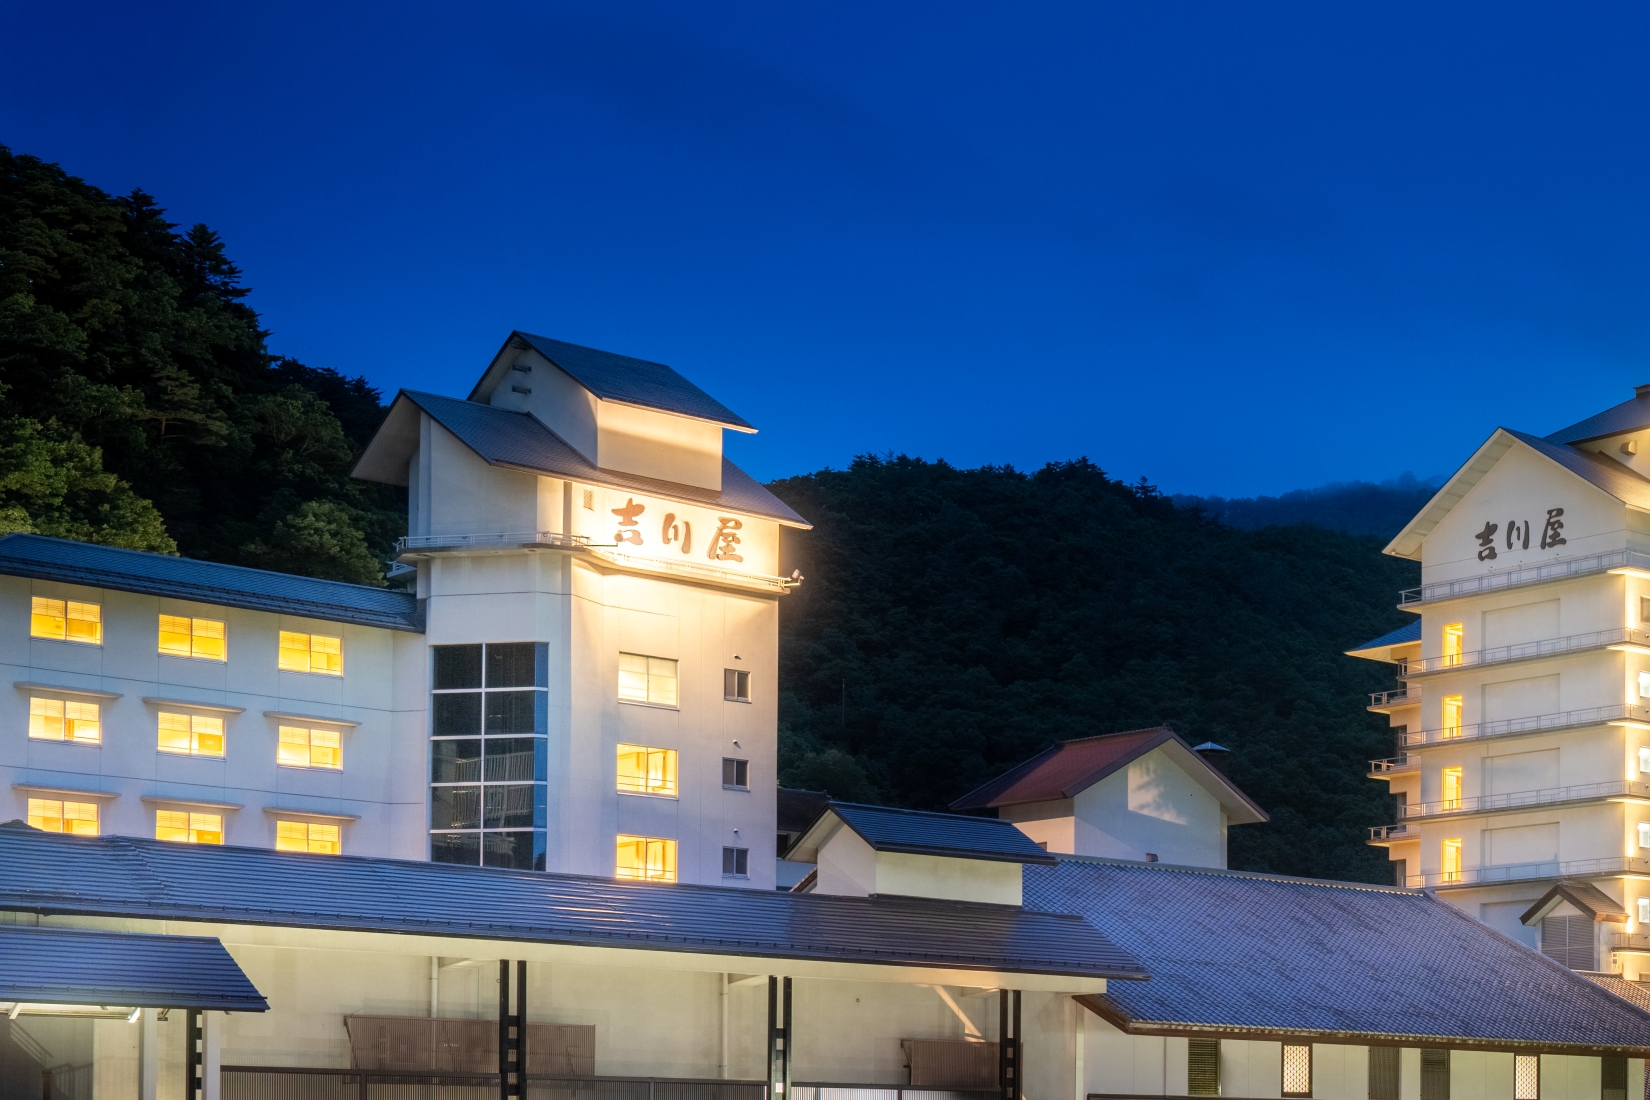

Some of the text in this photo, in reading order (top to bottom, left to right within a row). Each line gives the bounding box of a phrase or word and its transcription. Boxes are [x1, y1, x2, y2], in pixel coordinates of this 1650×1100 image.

[611, 497, 744, 563] 吉川屋
[1475, 507, 1567, 561] 吉川屋
